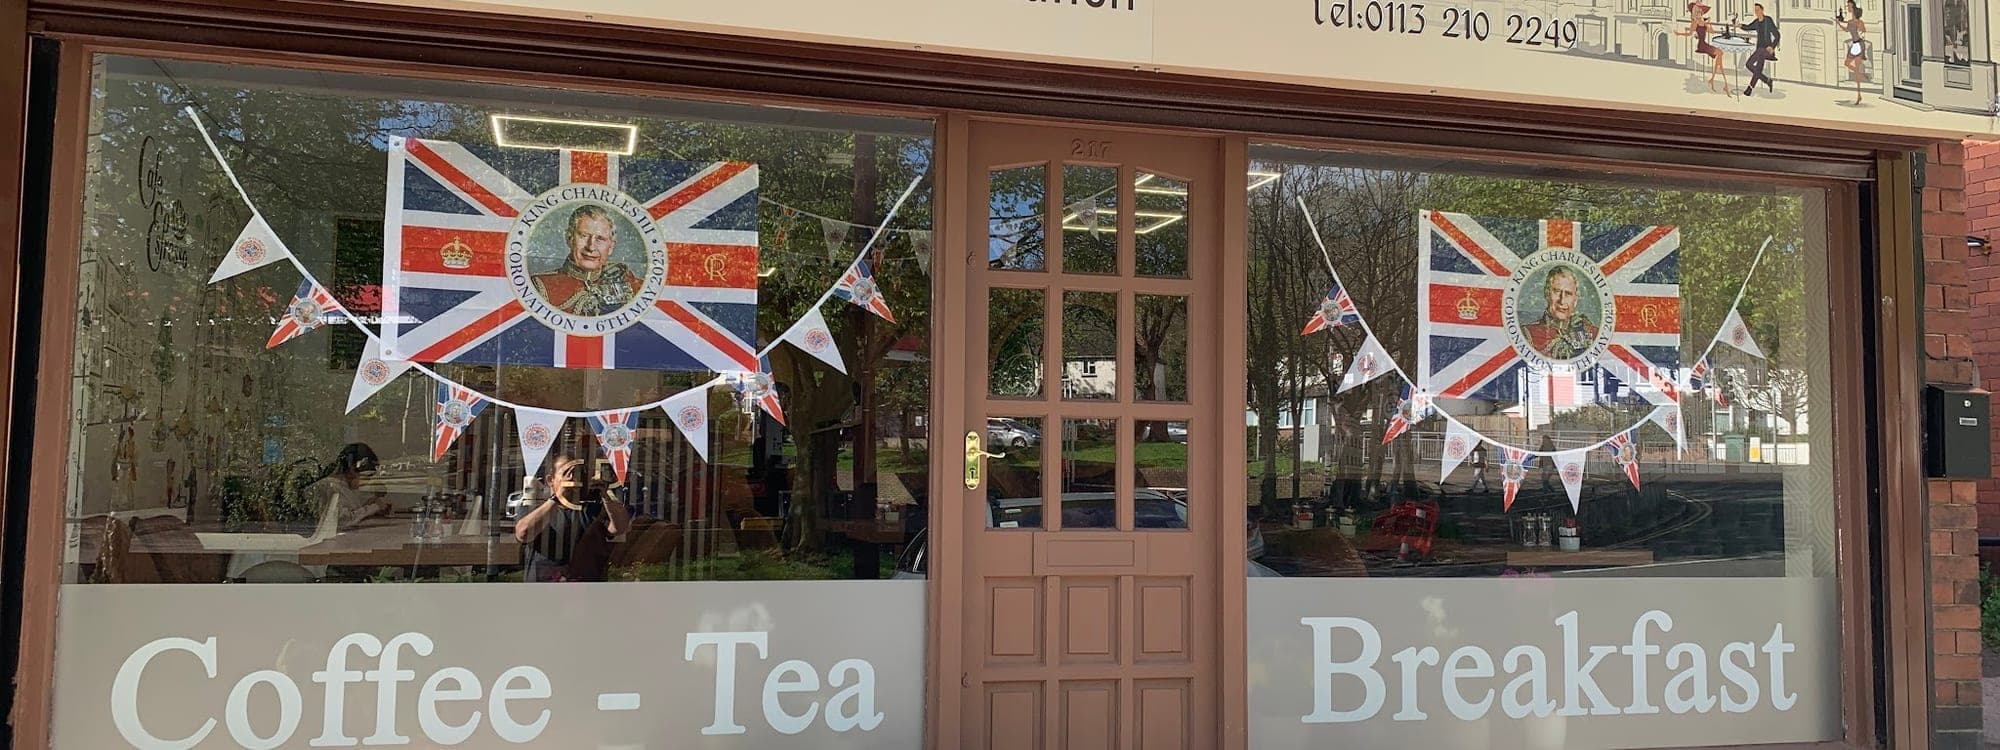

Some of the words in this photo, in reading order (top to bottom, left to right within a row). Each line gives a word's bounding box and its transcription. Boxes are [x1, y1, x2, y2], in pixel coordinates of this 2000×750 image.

[1442, 8, 1490, 41] 210
[1506, 14, 1578, 49] 2249
[1071, 138, 1113, 159] 217
[521, 193, 559, 229] KING
[561, 187, 641, 218] CHARLES
[636, 215, 656, 235] III
[509, 241, 577, 332] CORONATION
[595, 312, 632, 333] 6TH
[632, 289, 658, 317] MAY
[651, 249, 665, 286] 2023
[1512, 256, 1539, 286] KING
[1540, 250, 1598, 278] CHARLES
[1592, 272, 1607, 290] III
[1504, 296, 1554, 372] CORONATION
[1591, 335, 1609, 359] MAY
[1604, 301, 1613, 332] 2023
[111, 632, 552, 750] Coffee
[685, 631, 885, 736] Tea
[1301, 610, 1798, 725] Breakfast
